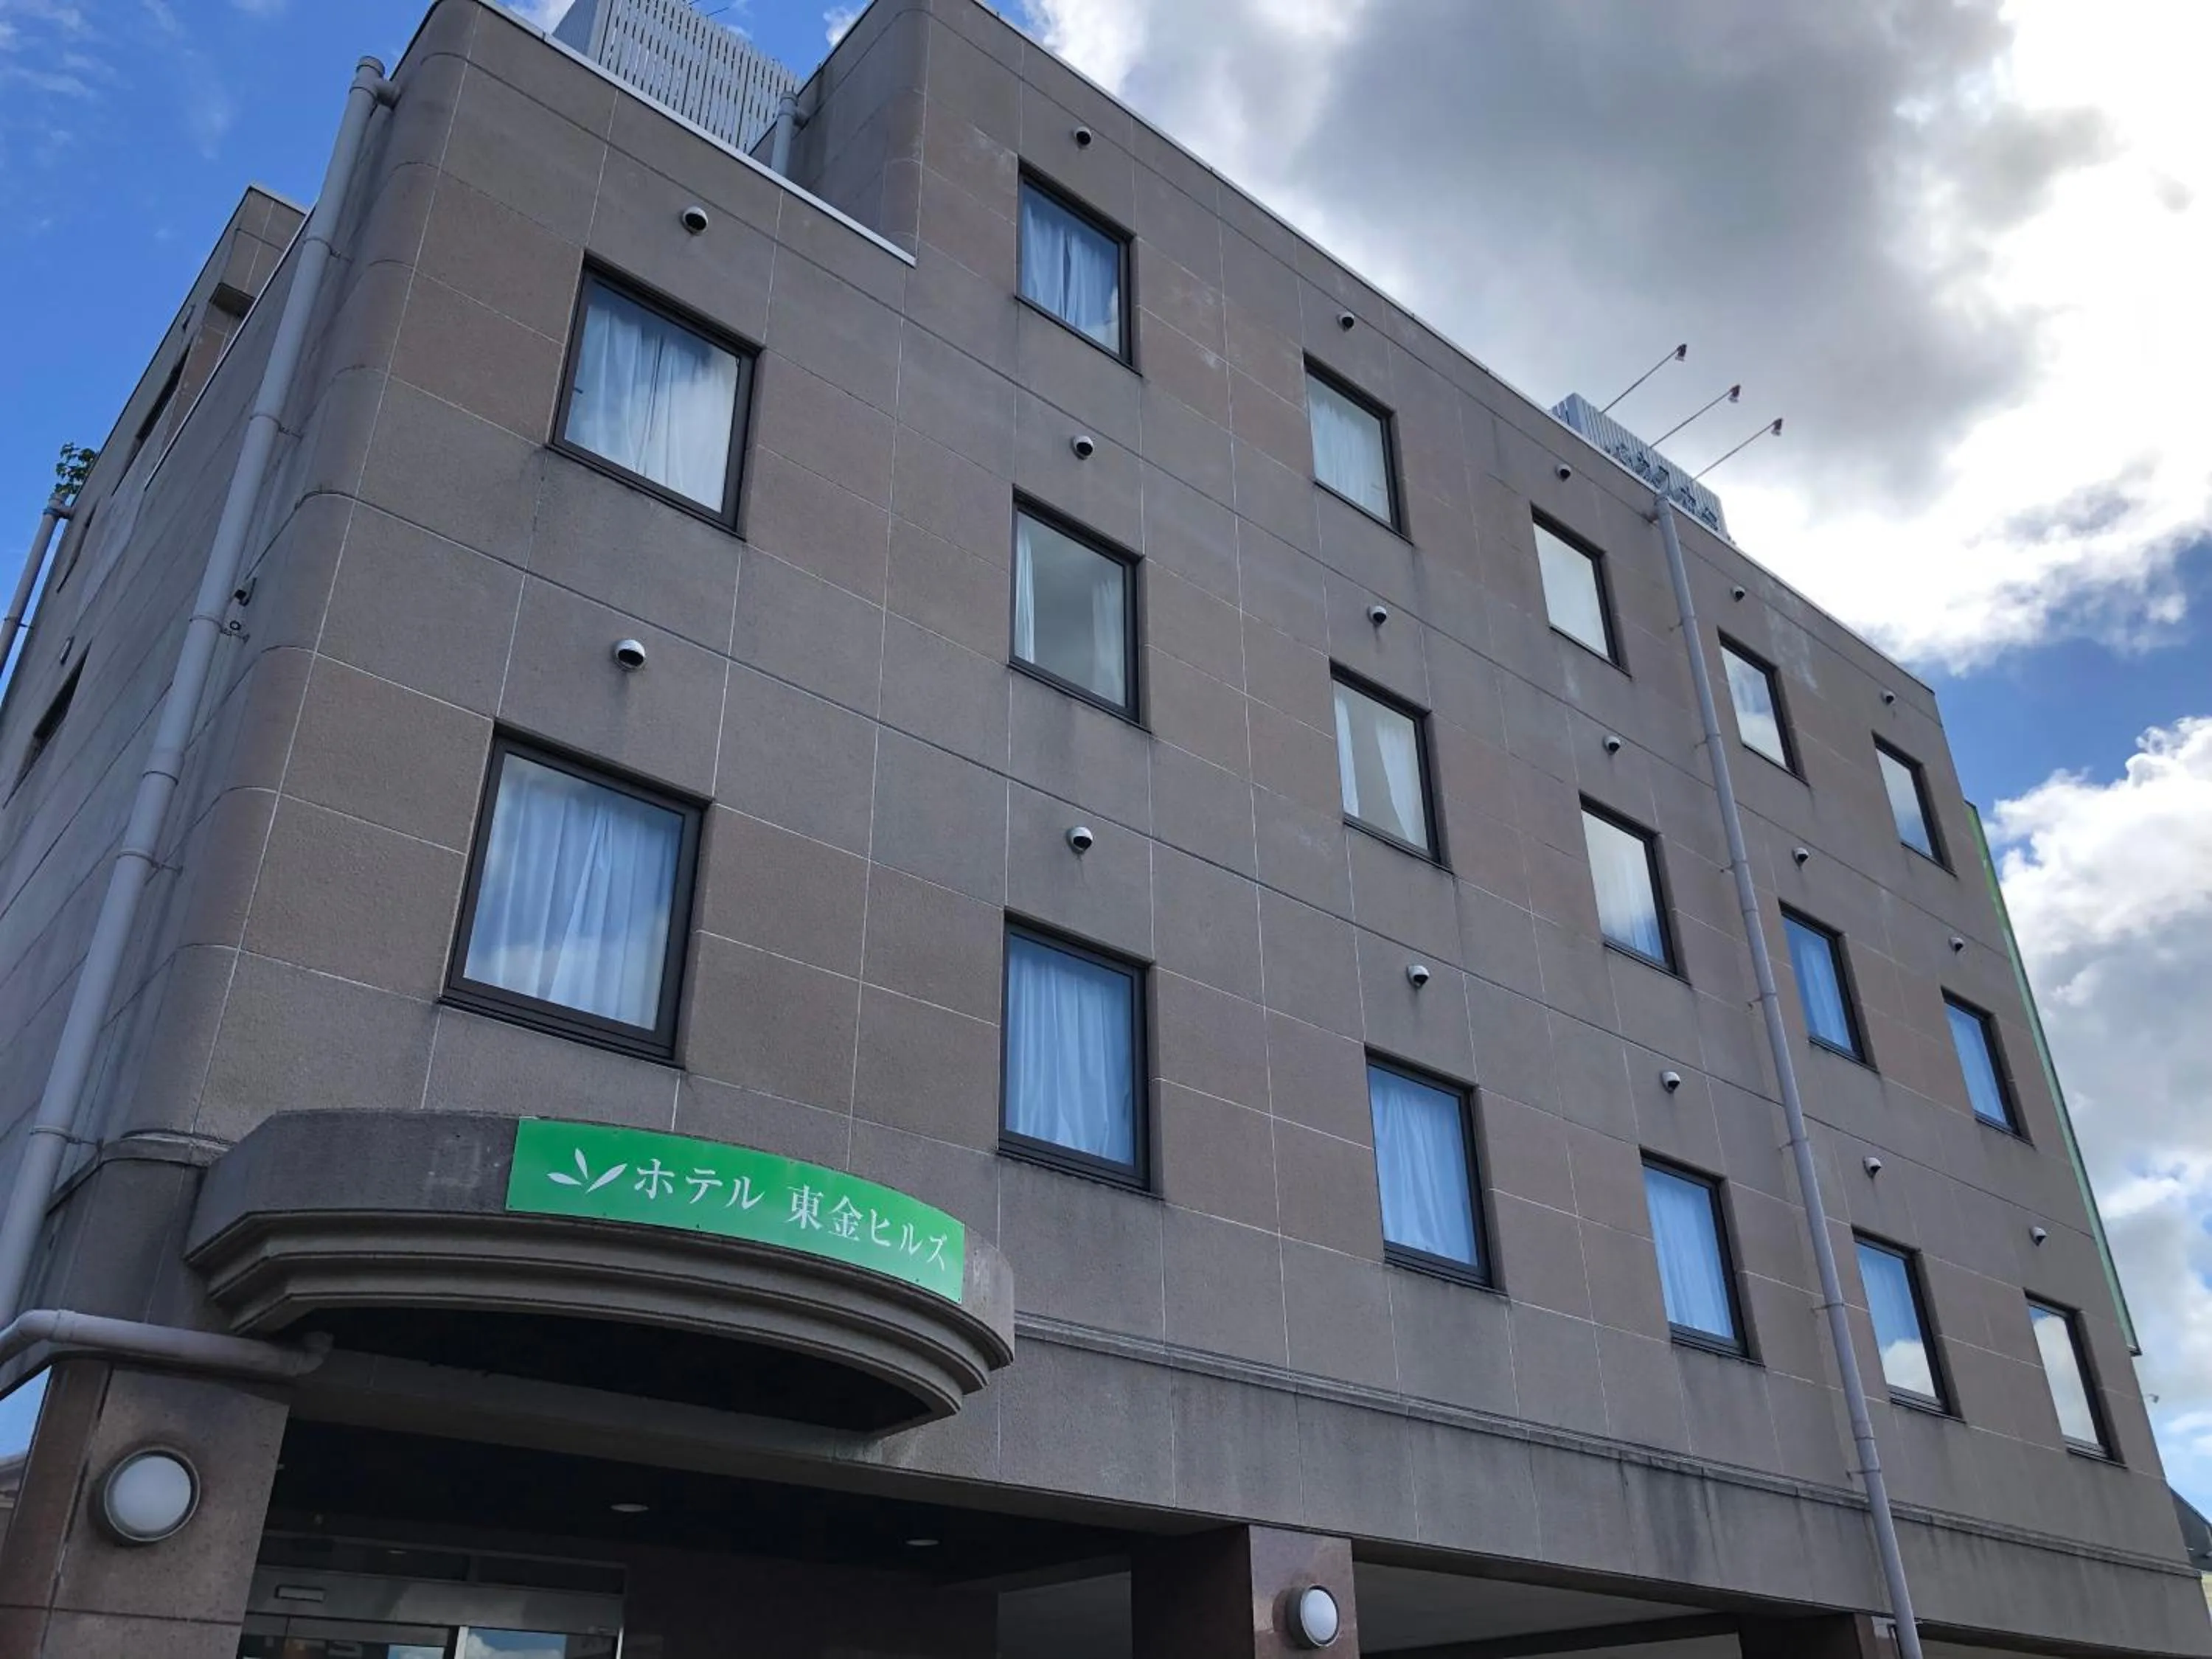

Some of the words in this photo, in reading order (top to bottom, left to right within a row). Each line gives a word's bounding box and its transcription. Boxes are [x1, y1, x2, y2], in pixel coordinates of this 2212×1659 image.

[634, 1158, 765, 1209] ホテル
[785, 1185, 947, 1271] 東金ヒルズ
